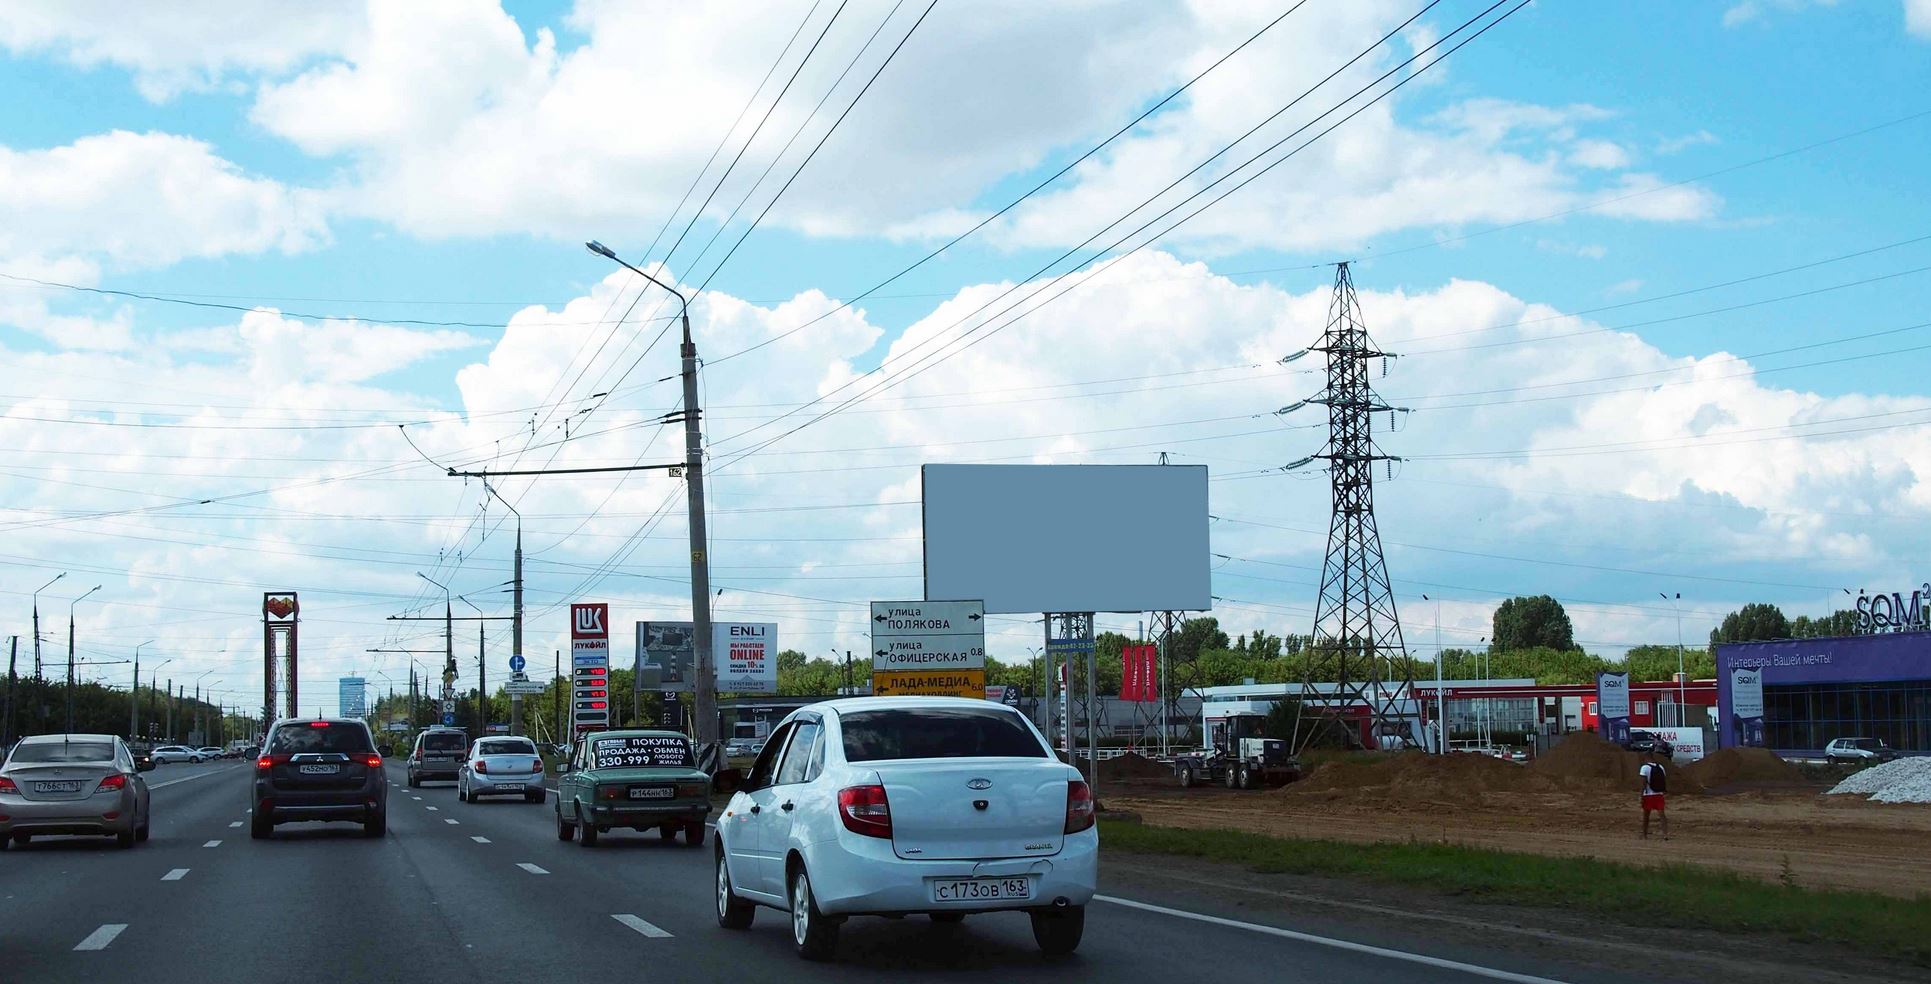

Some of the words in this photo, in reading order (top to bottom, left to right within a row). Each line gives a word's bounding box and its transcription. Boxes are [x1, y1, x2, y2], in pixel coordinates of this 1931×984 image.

[889, 609, 921, 618] улица
[888, 620, 950, 629] ПОЛЯКОВА
[730, 626, 765, 636] ENLI
[575, 641, 606, 649] ЛУКОЙЛ
[889, 642, 922, 652] улица
[730, 650, 765, 660] ONLINE
[970, 648, 983, 656] 0.8
[889, 653, 967, 663] ОФИЦЕРСКАЯ
[1727, 656, 1772, 668] Интерьеры
[1774, 653, 1801, 666] Вашей
[1803, 652, 1833, 664] мечты!
[890, 677, 970, 689] ЛАДА-МЕДИА
[632, 738, 684, 746] ПОКУПКА
[599, 747, 646, 757] ПРОДАЖА
[653, 747, 686, 755] ОБМЕН
[599, 755, 650, 767] 330-999
